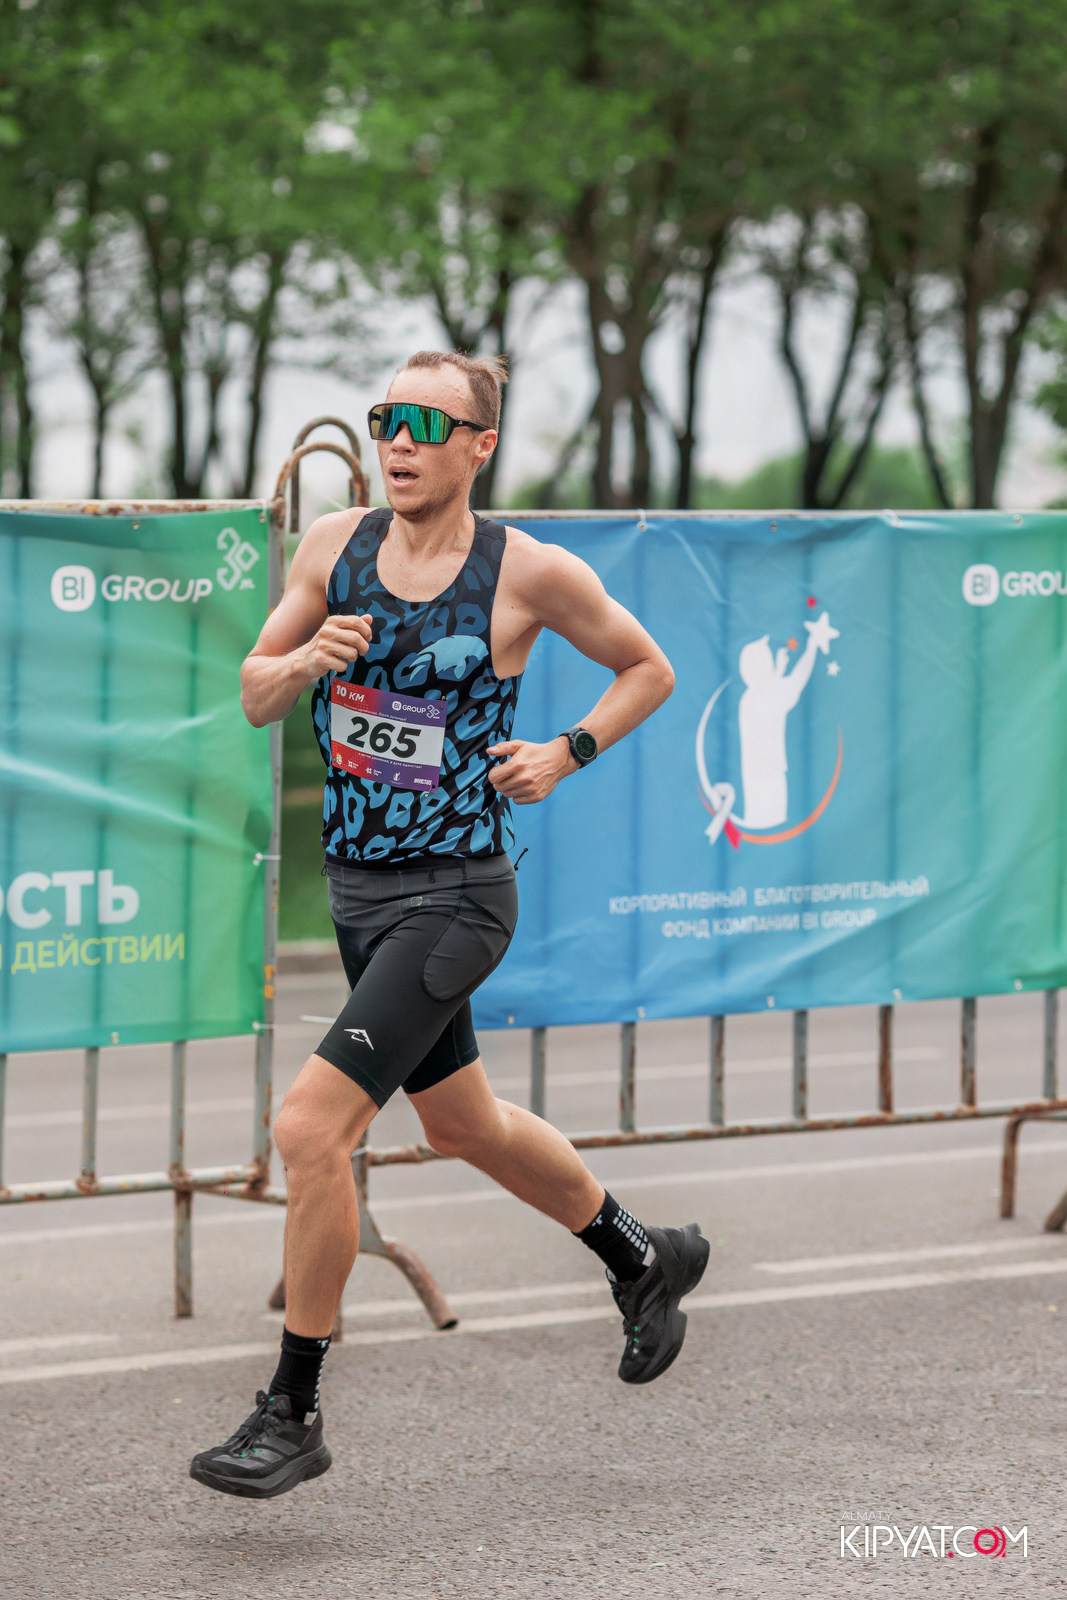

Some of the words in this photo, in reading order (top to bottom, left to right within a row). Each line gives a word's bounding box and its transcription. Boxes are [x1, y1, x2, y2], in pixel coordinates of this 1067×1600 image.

[101, 575, 213, 604] GROUP
[336, 685, 347, 697] 10
[348, 691, 366, 703] KM
[402, 704, 427, 714] GROUP
[346, 716, 422, 759] 265
[0, 869, 140, 930] СТЬ
[608, 886, 747, 915] КОРПОРАТИВНЫЙ
[754, 875, 930, 907] БЛАГОТВОРИТЕЛЬНЫЙ
[661, 918, 710, 939] ФОНД
[712, 913, 799, 936] КОМПАНИИ
[820, 907, 877, 929] GROUP
[11, 932, 186, 975] ДЕЙСТВИИ
